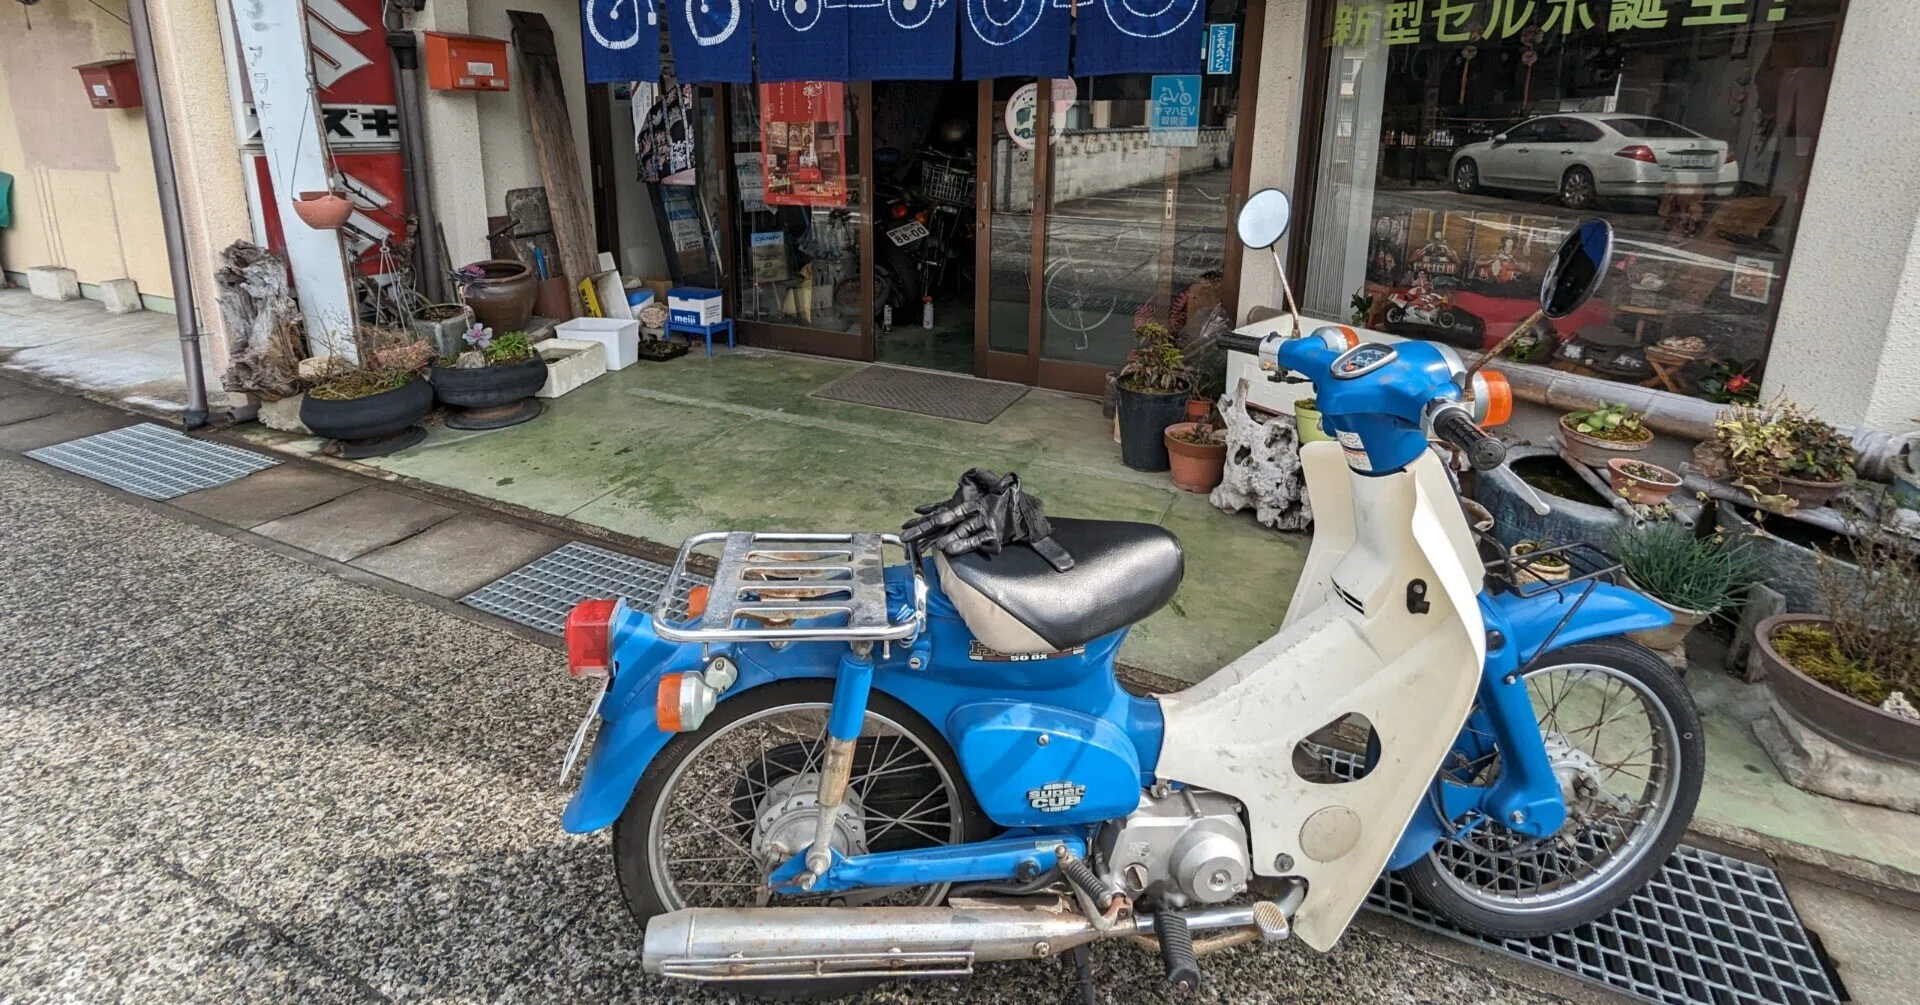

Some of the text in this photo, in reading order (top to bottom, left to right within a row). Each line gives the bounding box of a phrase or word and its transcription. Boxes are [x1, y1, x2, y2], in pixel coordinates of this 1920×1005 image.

[1155, 106, 1195, 116] ヤマハEV
[674, 314, 696, 325] meiji
[1031, 796, 1081, 808] CUB
